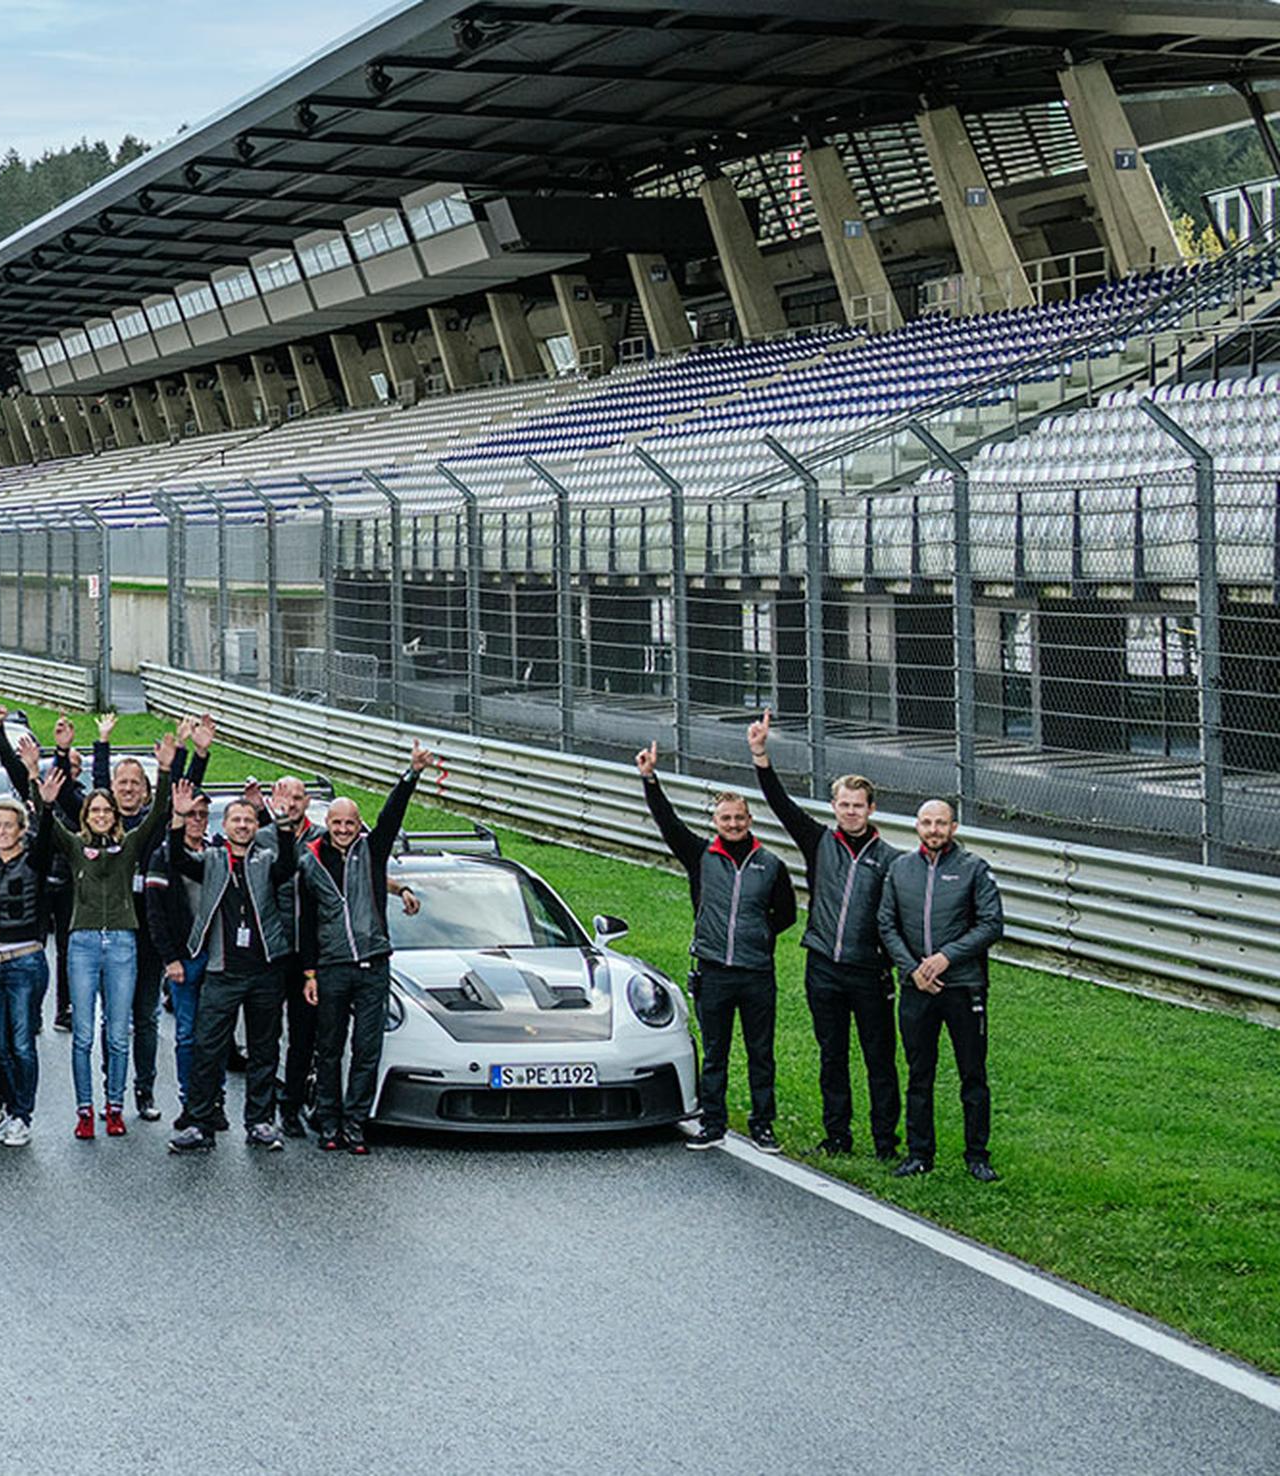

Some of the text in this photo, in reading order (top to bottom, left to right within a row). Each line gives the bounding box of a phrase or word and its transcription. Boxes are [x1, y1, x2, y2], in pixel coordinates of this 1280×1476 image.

[502, 1066, 594, 1085] S PE 1192
